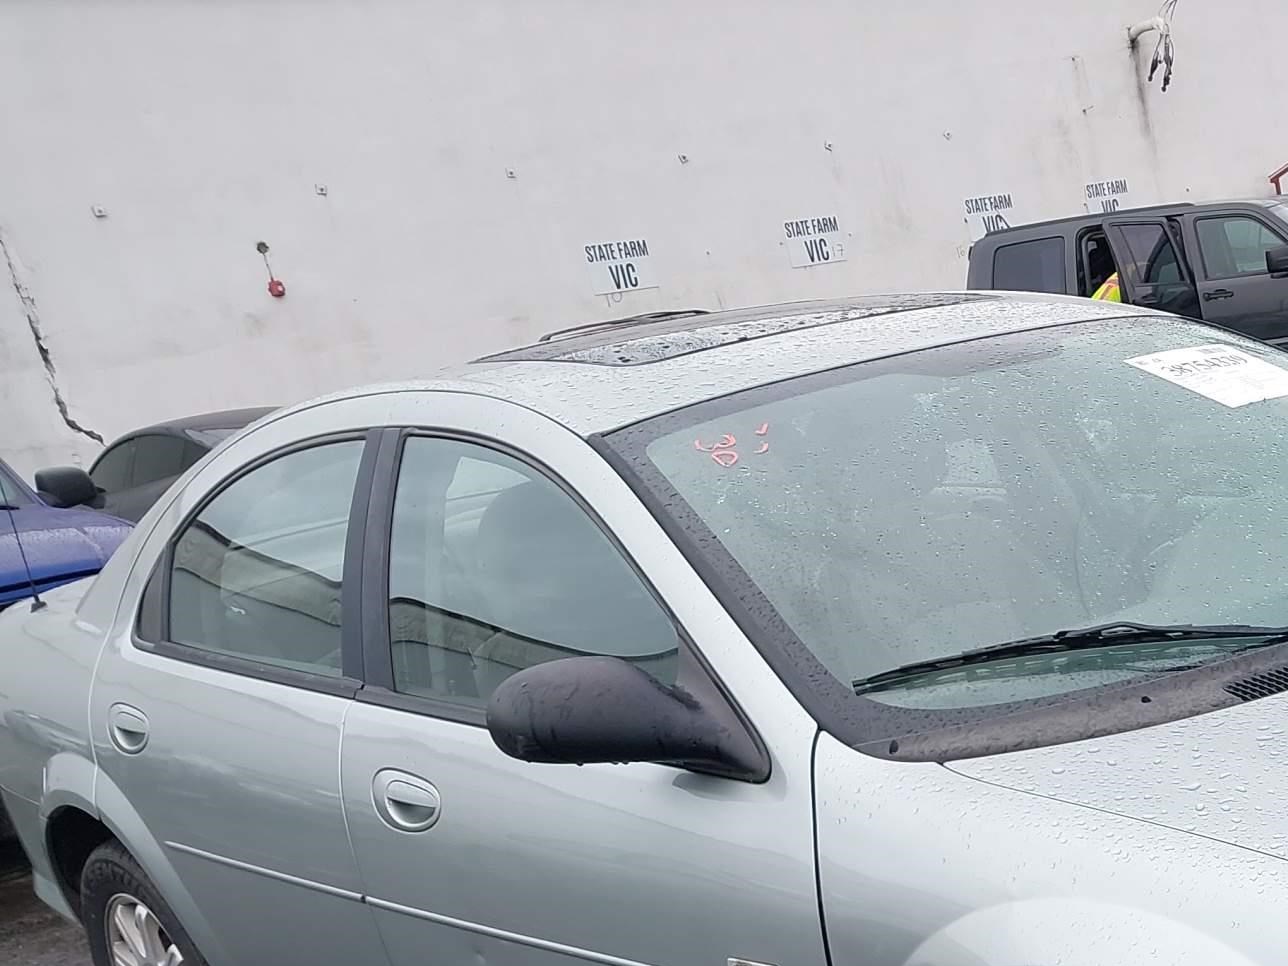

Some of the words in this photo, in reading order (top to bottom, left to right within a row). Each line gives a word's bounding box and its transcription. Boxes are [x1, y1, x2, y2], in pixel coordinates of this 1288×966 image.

[1086, 182, 1107, 199] STATE
[1106, 179, 1128, 195] FARM
[964, 196, 989, 214] STATE
[988, 193, 1013, 211] FARM
[784, 220, 811, 238] STATE
[811, 216, 839, 234] FARM
[584, 243, 617, 262] STATE
[616, 239, 649, 259] FARM
[804, 238, 829, 262] VIC
[608, 263, 638, 290] VIC
